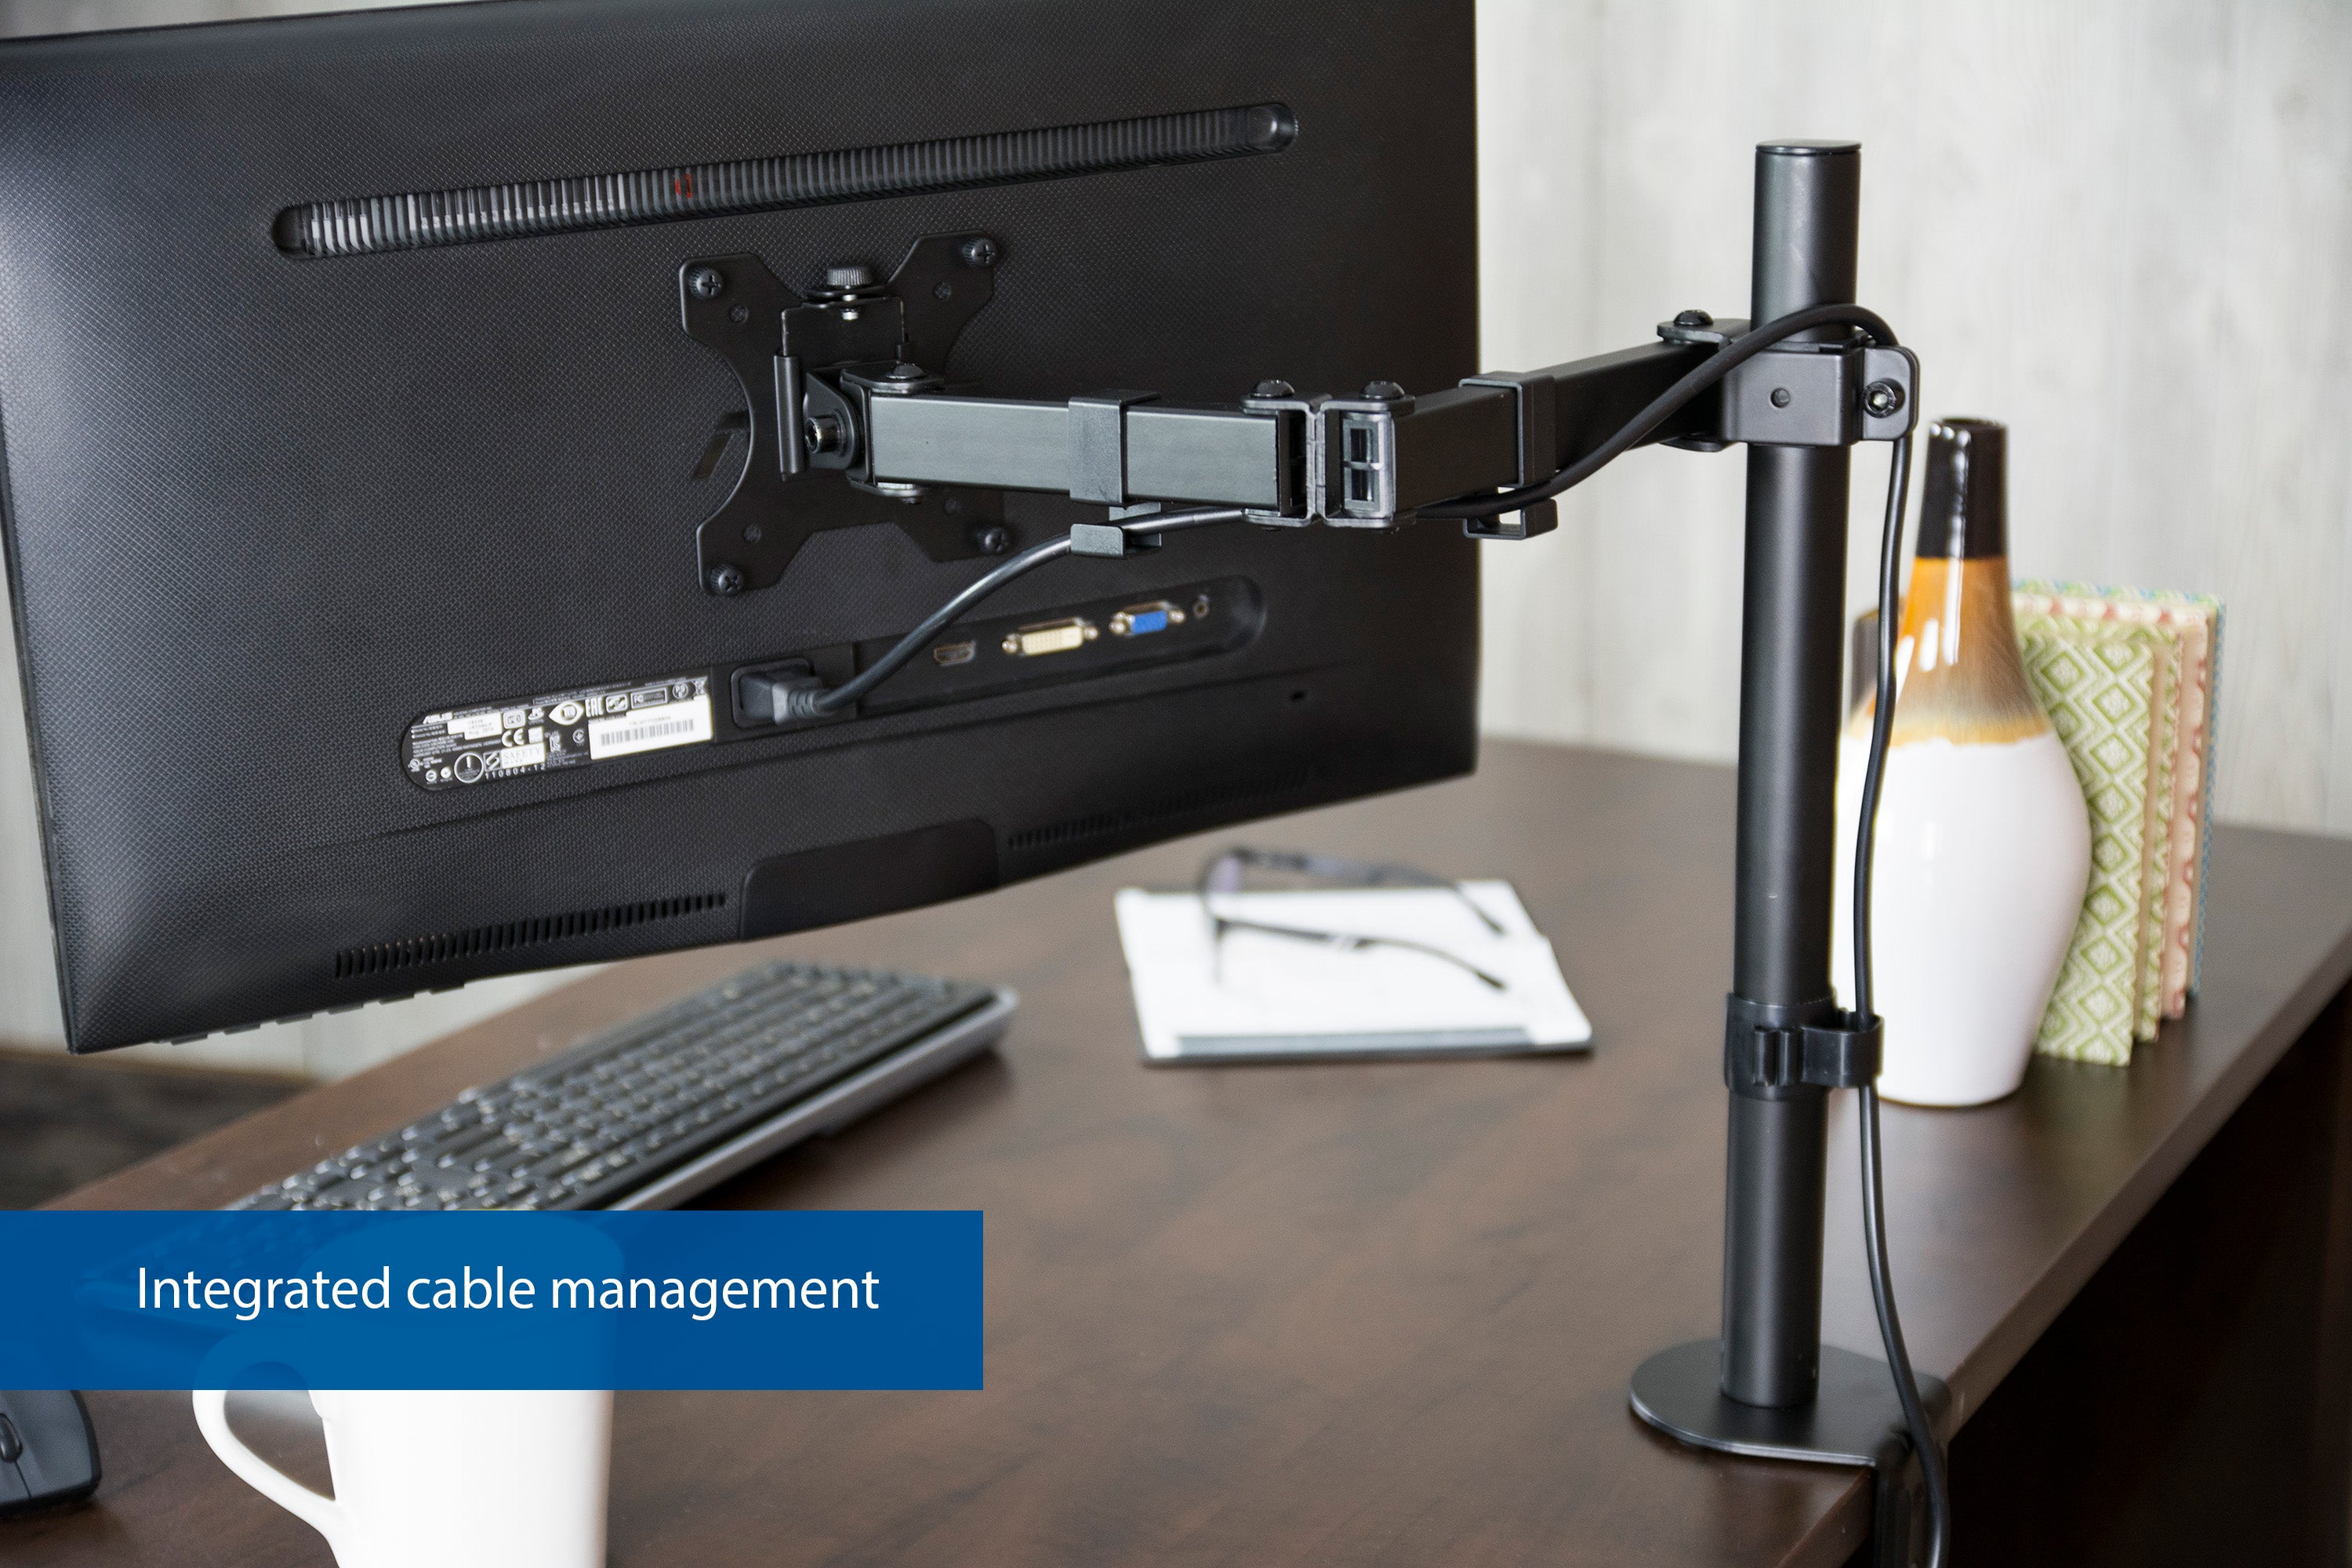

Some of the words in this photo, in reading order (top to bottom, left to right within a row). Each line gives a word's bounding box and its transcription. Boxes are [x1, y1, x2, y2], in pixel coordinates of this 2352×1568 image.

[423, 712, 453, 724] ASUS
[501, 727, 525, 748] CE
[503, 747, 541, 760] SAFETY
[485, 763, 546, 780] 110804-12
